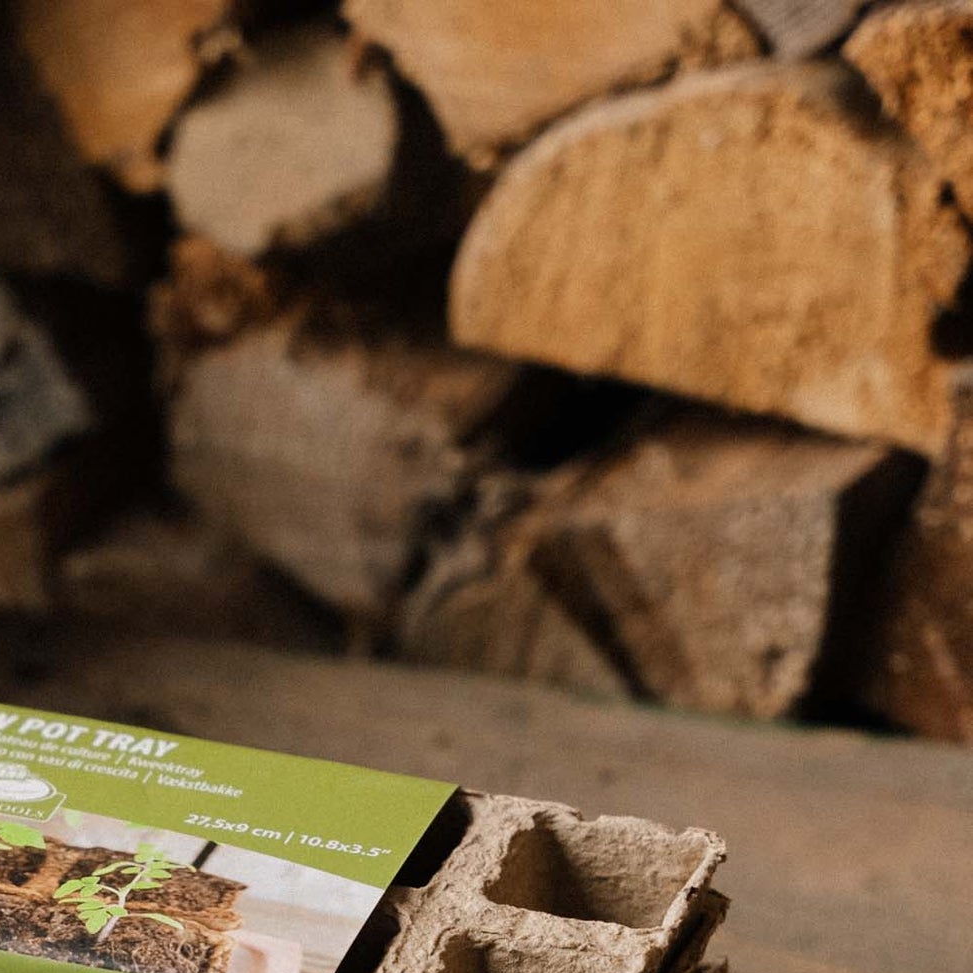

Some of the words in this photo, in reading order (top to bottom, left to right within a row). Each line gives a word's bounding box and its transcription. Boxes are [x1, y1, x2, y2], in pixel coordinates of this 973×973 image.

[18, 717, 89, 744] POT
[93, 730, 179, 758] TRAY
[38, 753, 66, 767] vasi
[67, 758, 83, 770] di
[84, 762, 139, 780] crescita
[128, 756, 205, 777] Kweektray
[183, 813, 250, 833] 27,5x9
[251, 827, 281, 840] cm
